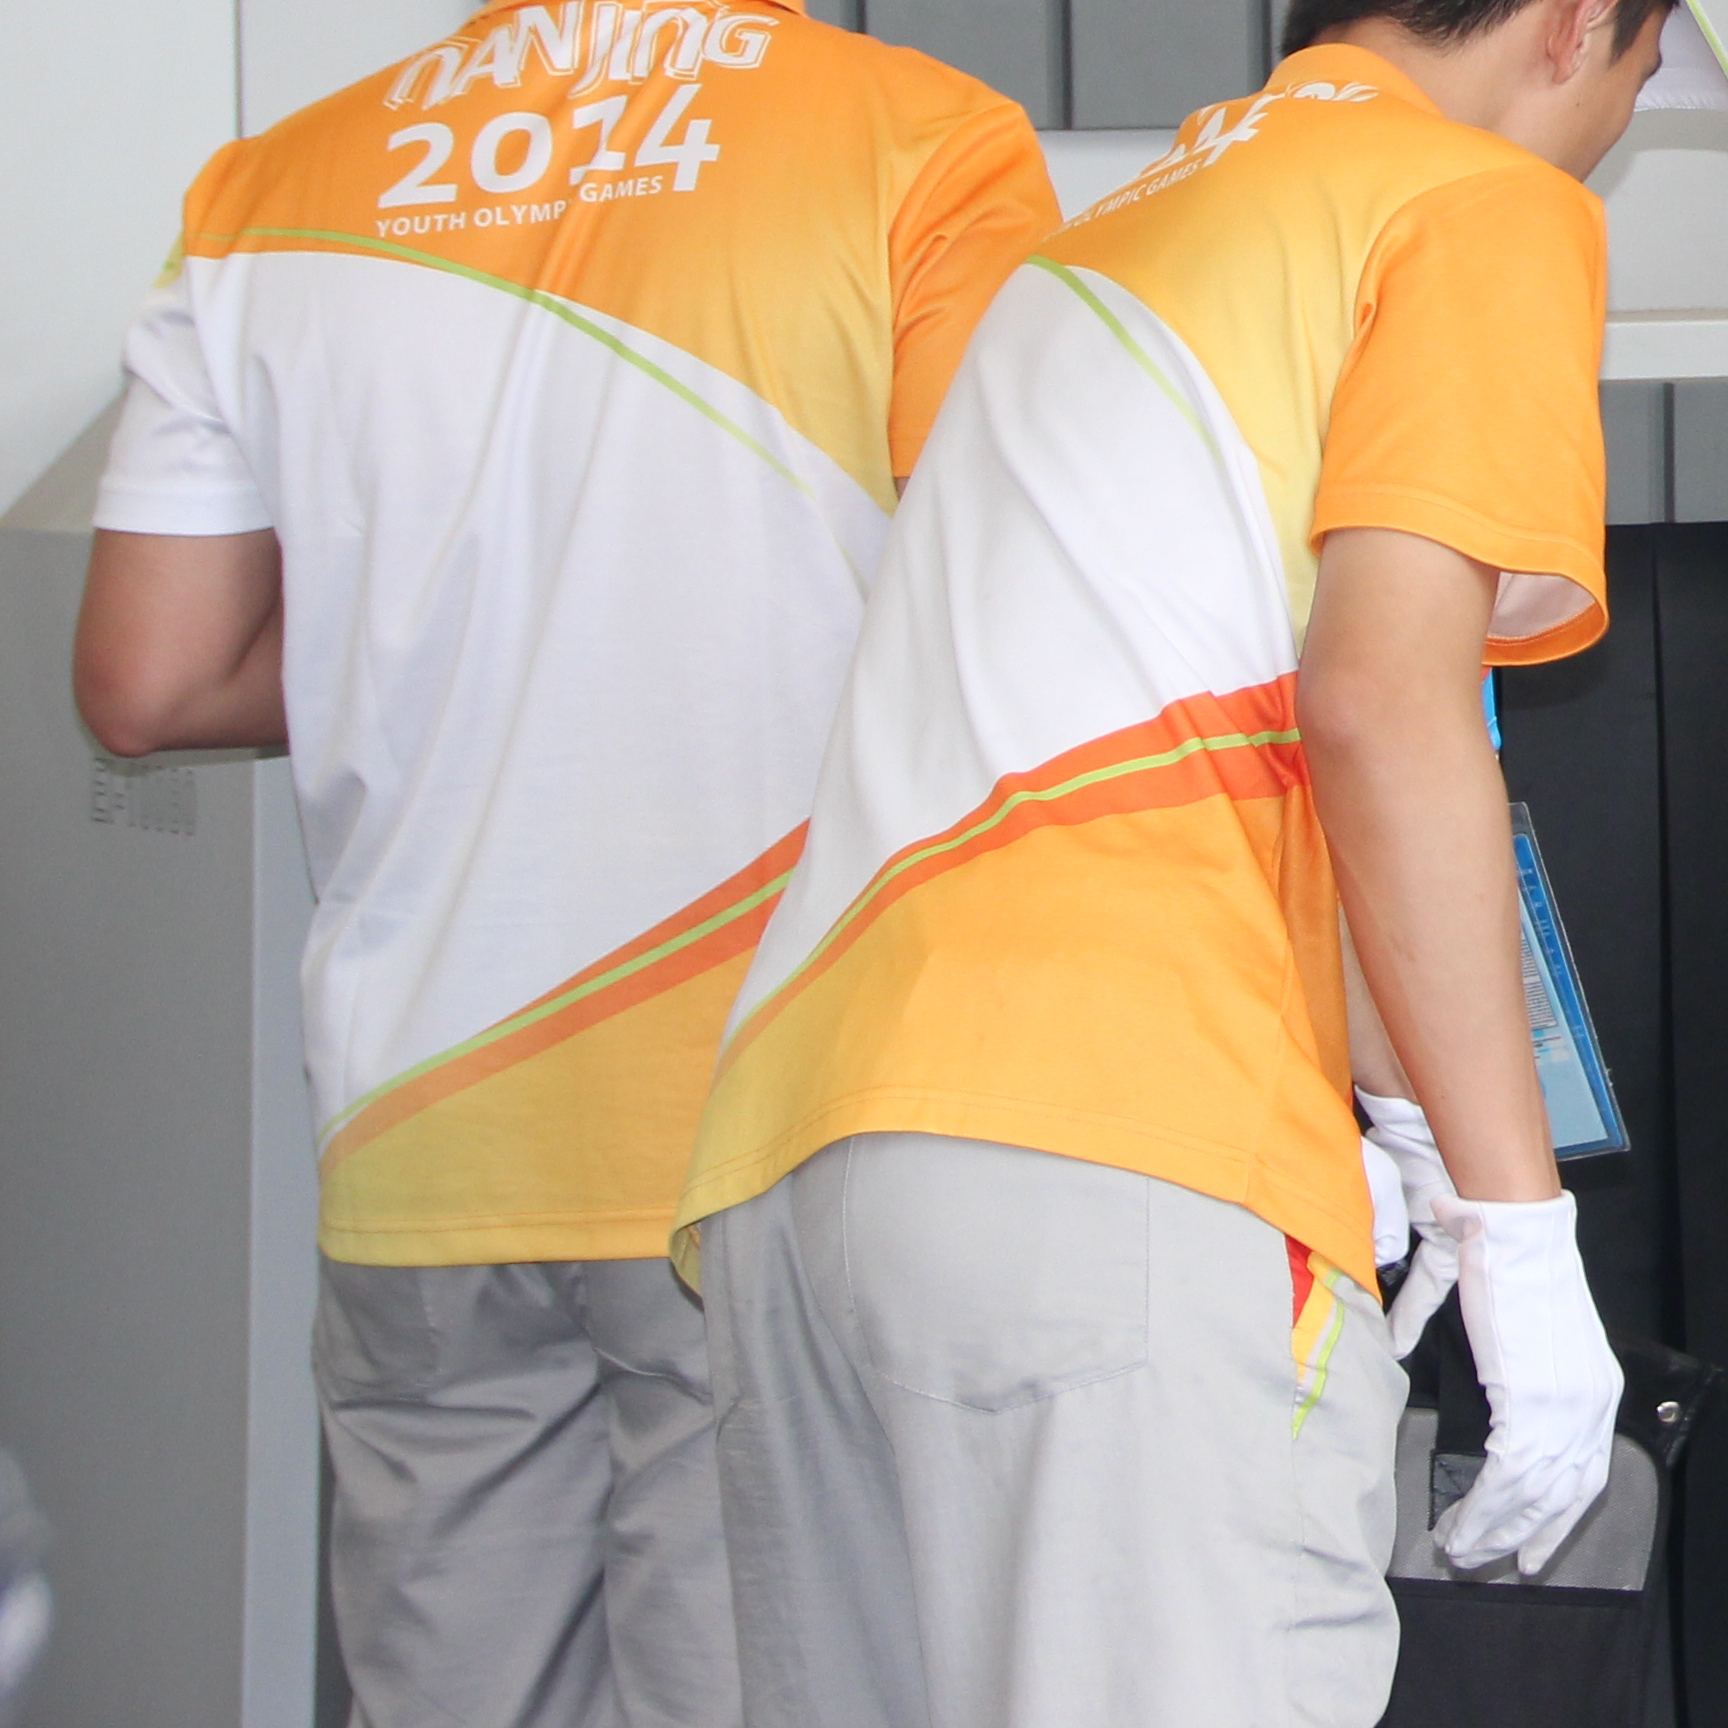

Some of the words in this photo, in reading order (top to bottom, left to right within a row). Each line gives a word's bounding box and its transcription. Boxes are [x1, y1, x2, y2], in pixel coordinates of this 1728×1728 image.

[377, 83, 720, 210] 2014
[1146, 159, 1202, 197] GAMES
[375, 211, 466, 238] YOUTH
[473, 199, 573, 229] OLYMP
[579, 175, 664, 204] GAMES
